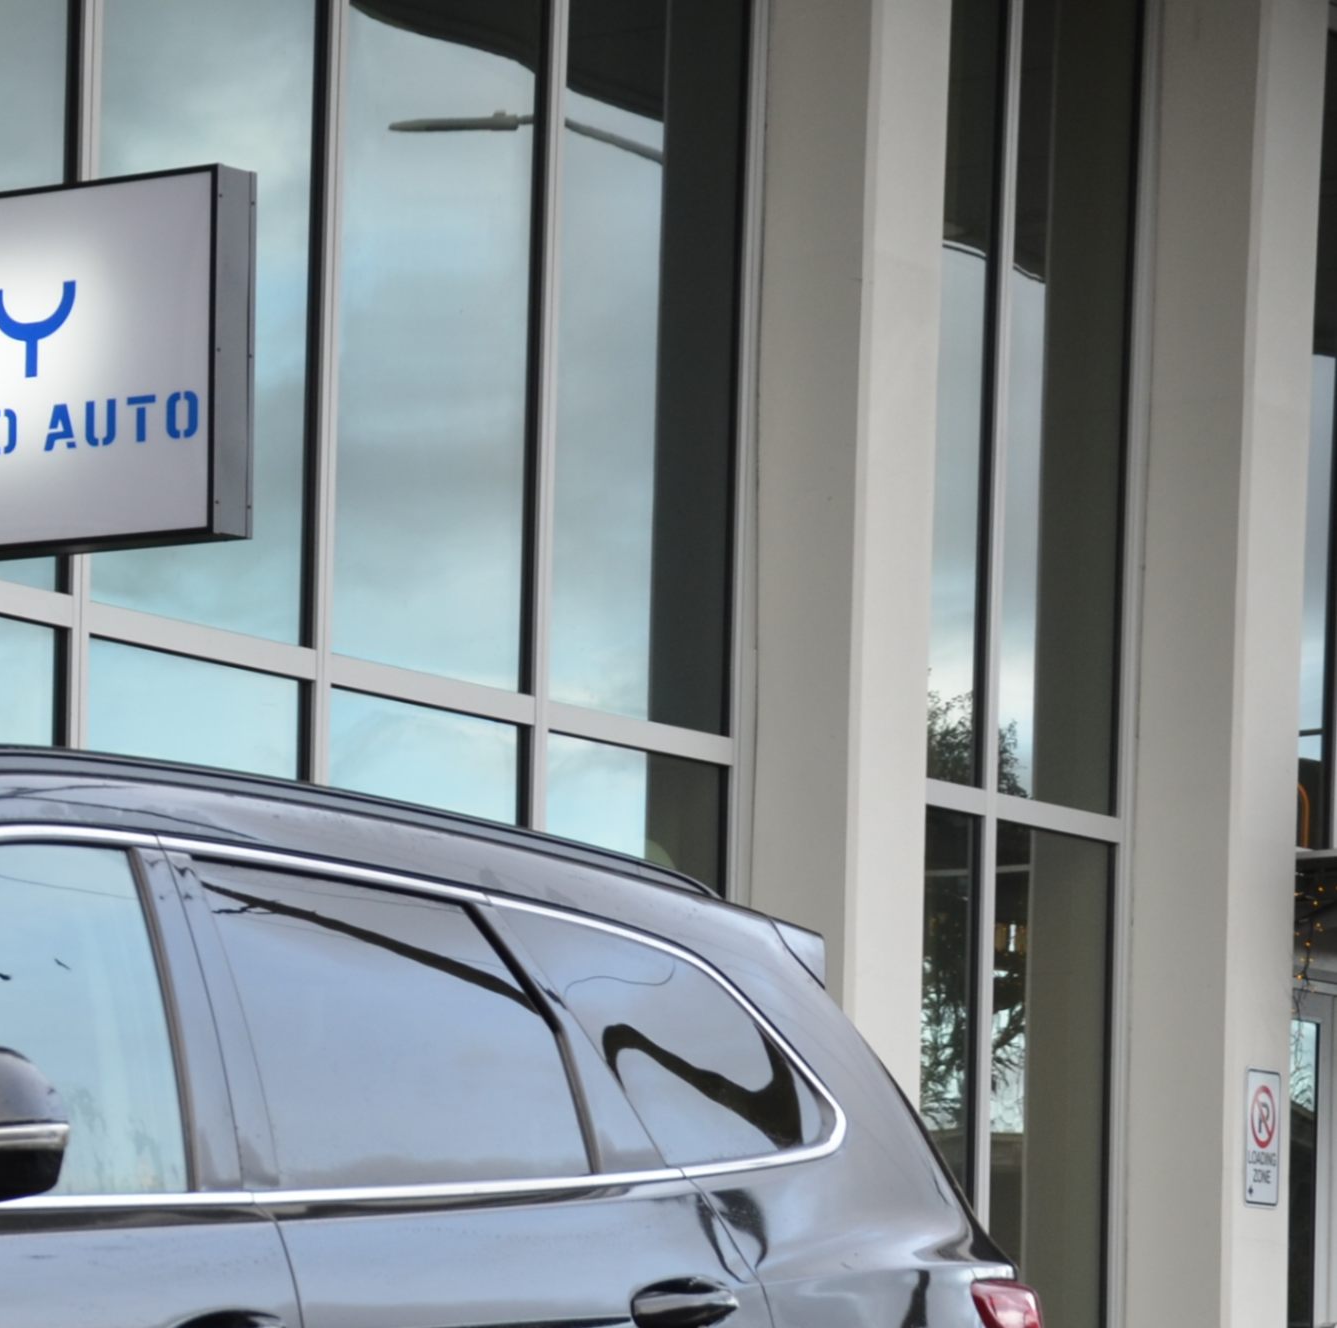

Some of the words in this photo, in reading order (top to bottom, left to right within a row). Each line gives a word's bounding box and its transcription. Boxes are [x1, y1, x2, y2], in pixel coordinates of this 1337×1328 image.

[44, 390, 199, 452] AUTO
[1248, 1150, 1277, 1167] LOADING
[1252, 1168, 1271, 1185] ZONE
